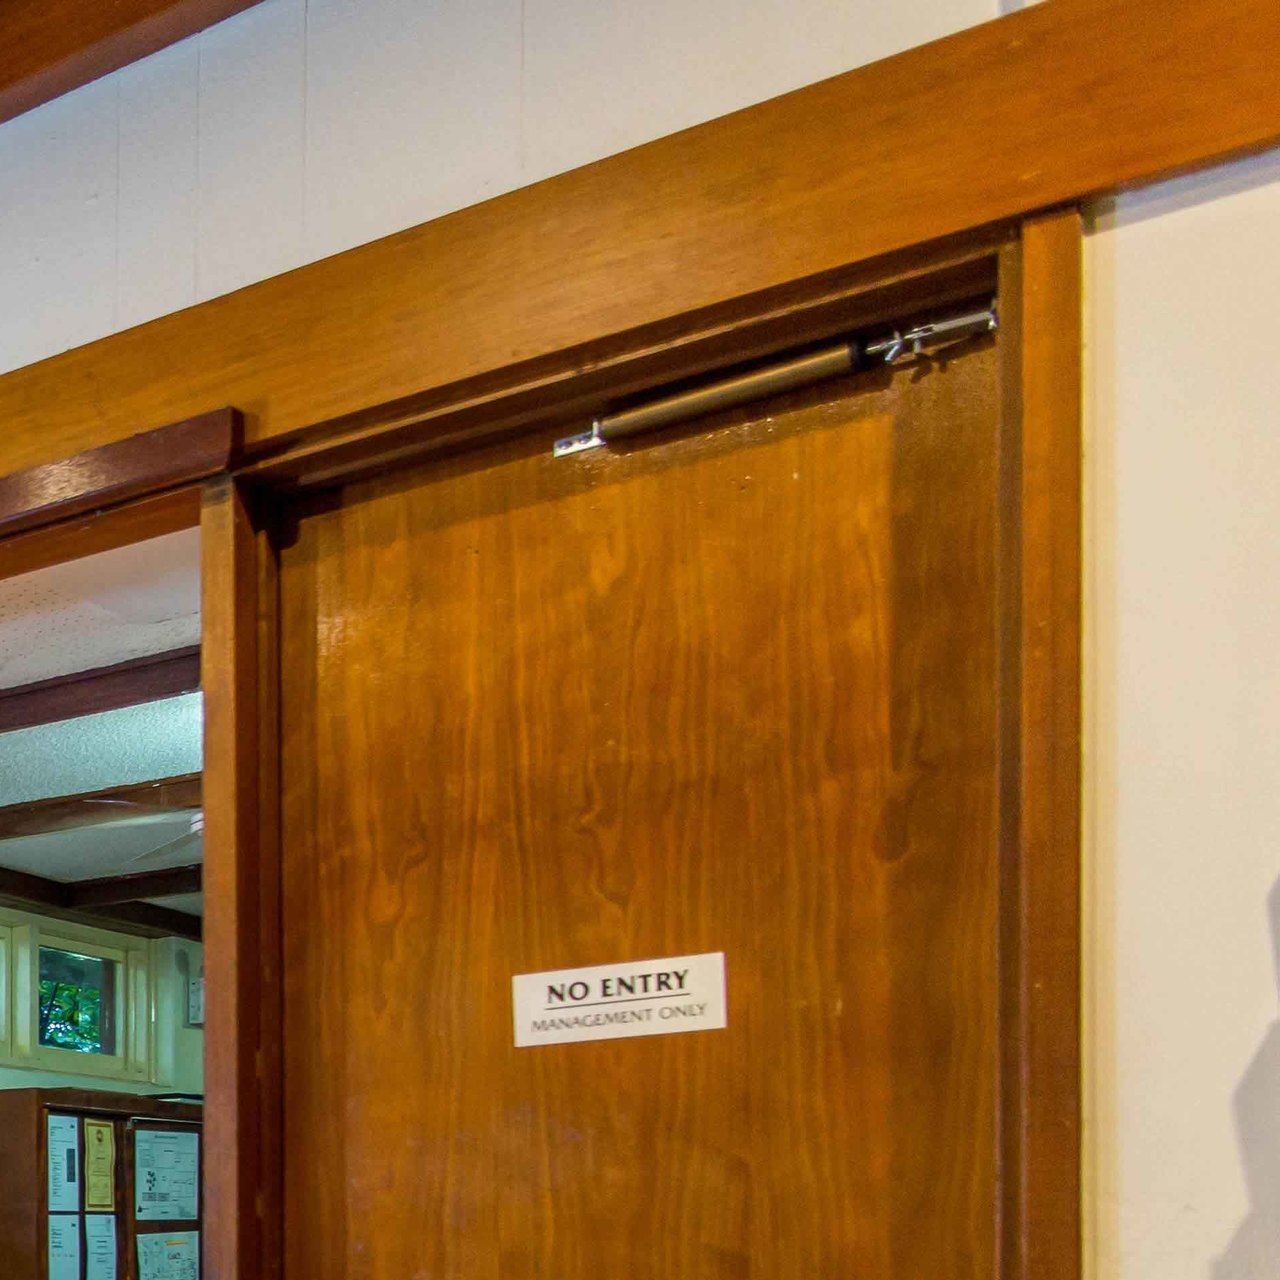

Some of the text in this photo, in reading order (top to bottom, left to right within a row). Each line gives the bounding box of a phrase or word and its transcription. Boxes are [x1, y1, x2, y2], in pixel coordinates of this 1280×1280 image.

[547, 969, 689, 1004] NO ENTRY
[531, 1003, 708, 1033] MANAGEMENT ONLY
